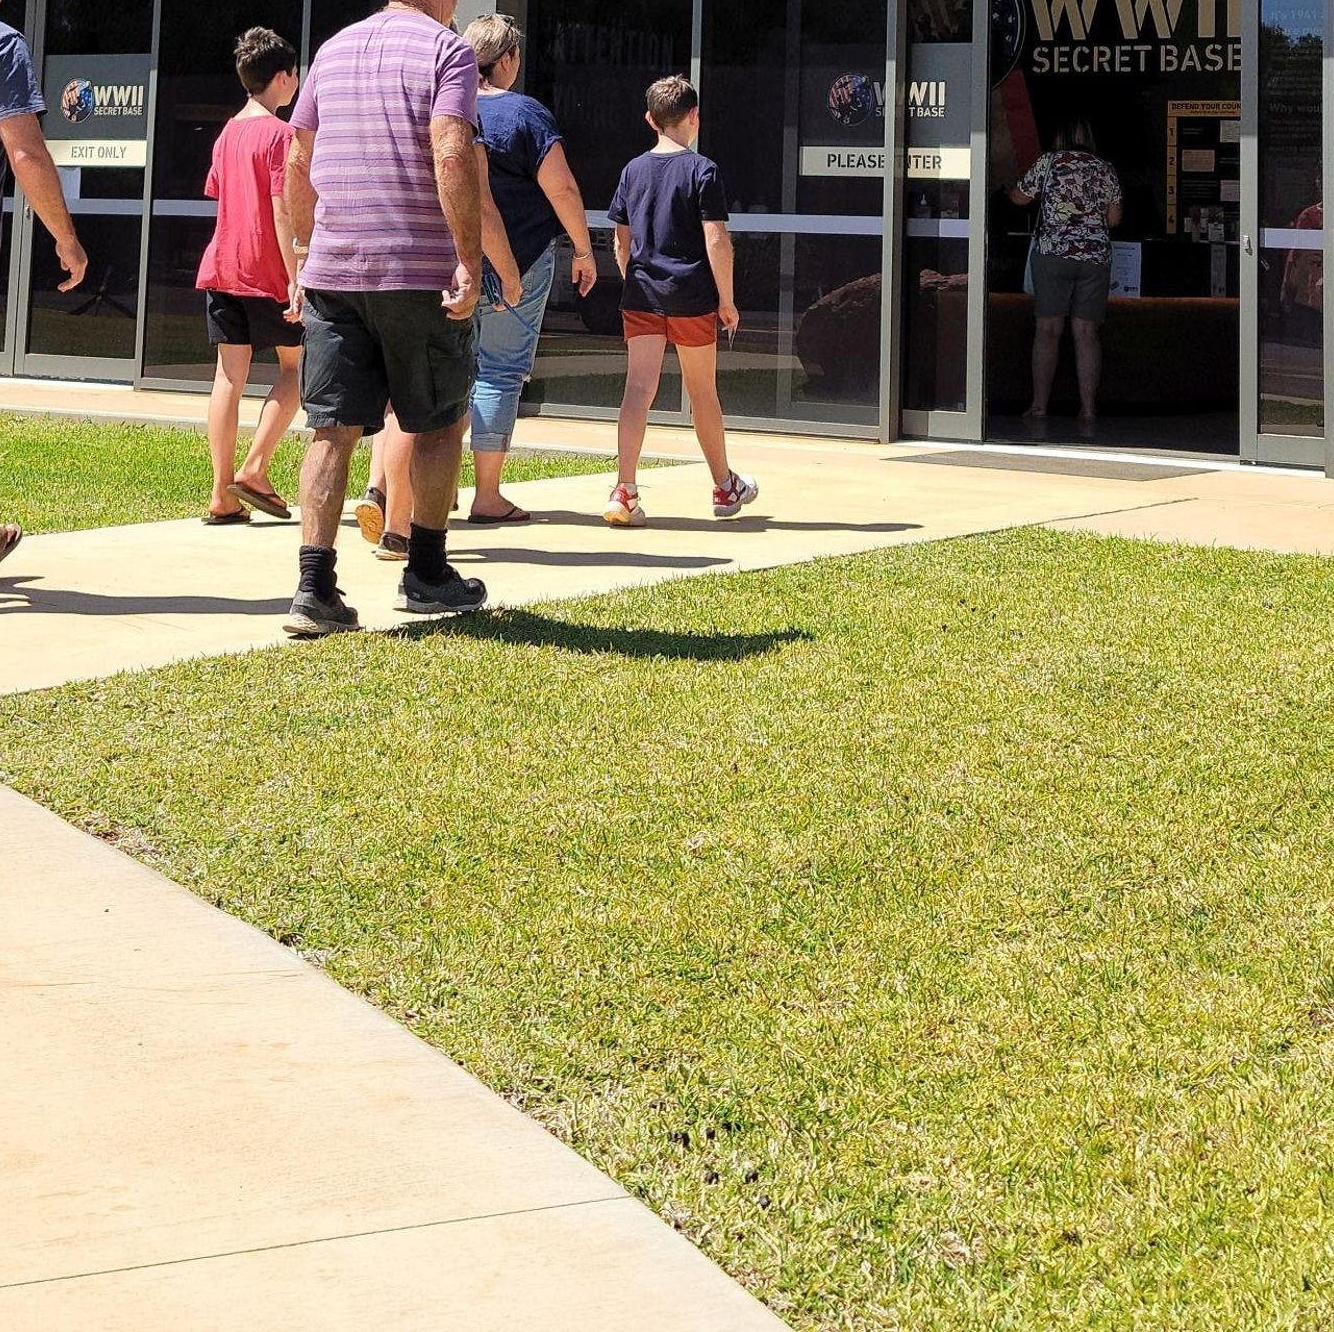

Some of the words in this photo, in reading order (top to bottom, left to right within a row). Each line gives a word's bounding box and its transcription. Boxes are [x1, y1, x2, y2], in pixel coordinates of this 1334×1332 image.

[1032, 44, 1153, 74] SECRET
[1160, 43, 1242, 72] BASE
[93, 85, 144, 106] WWII
[94, 106, 121, 116] SECRET
[122, 106, 143, 116] BASE
[917, 106, 945, 117] BASE
[1171, 102, 1200, 110] DEFEND
[1201, 102, 1221, 110] YOUR
[70, 146, 95, 158] EXIT
[97, 146, 127, 158] ONLY
[827, 153, 885, 169] PLEASE
